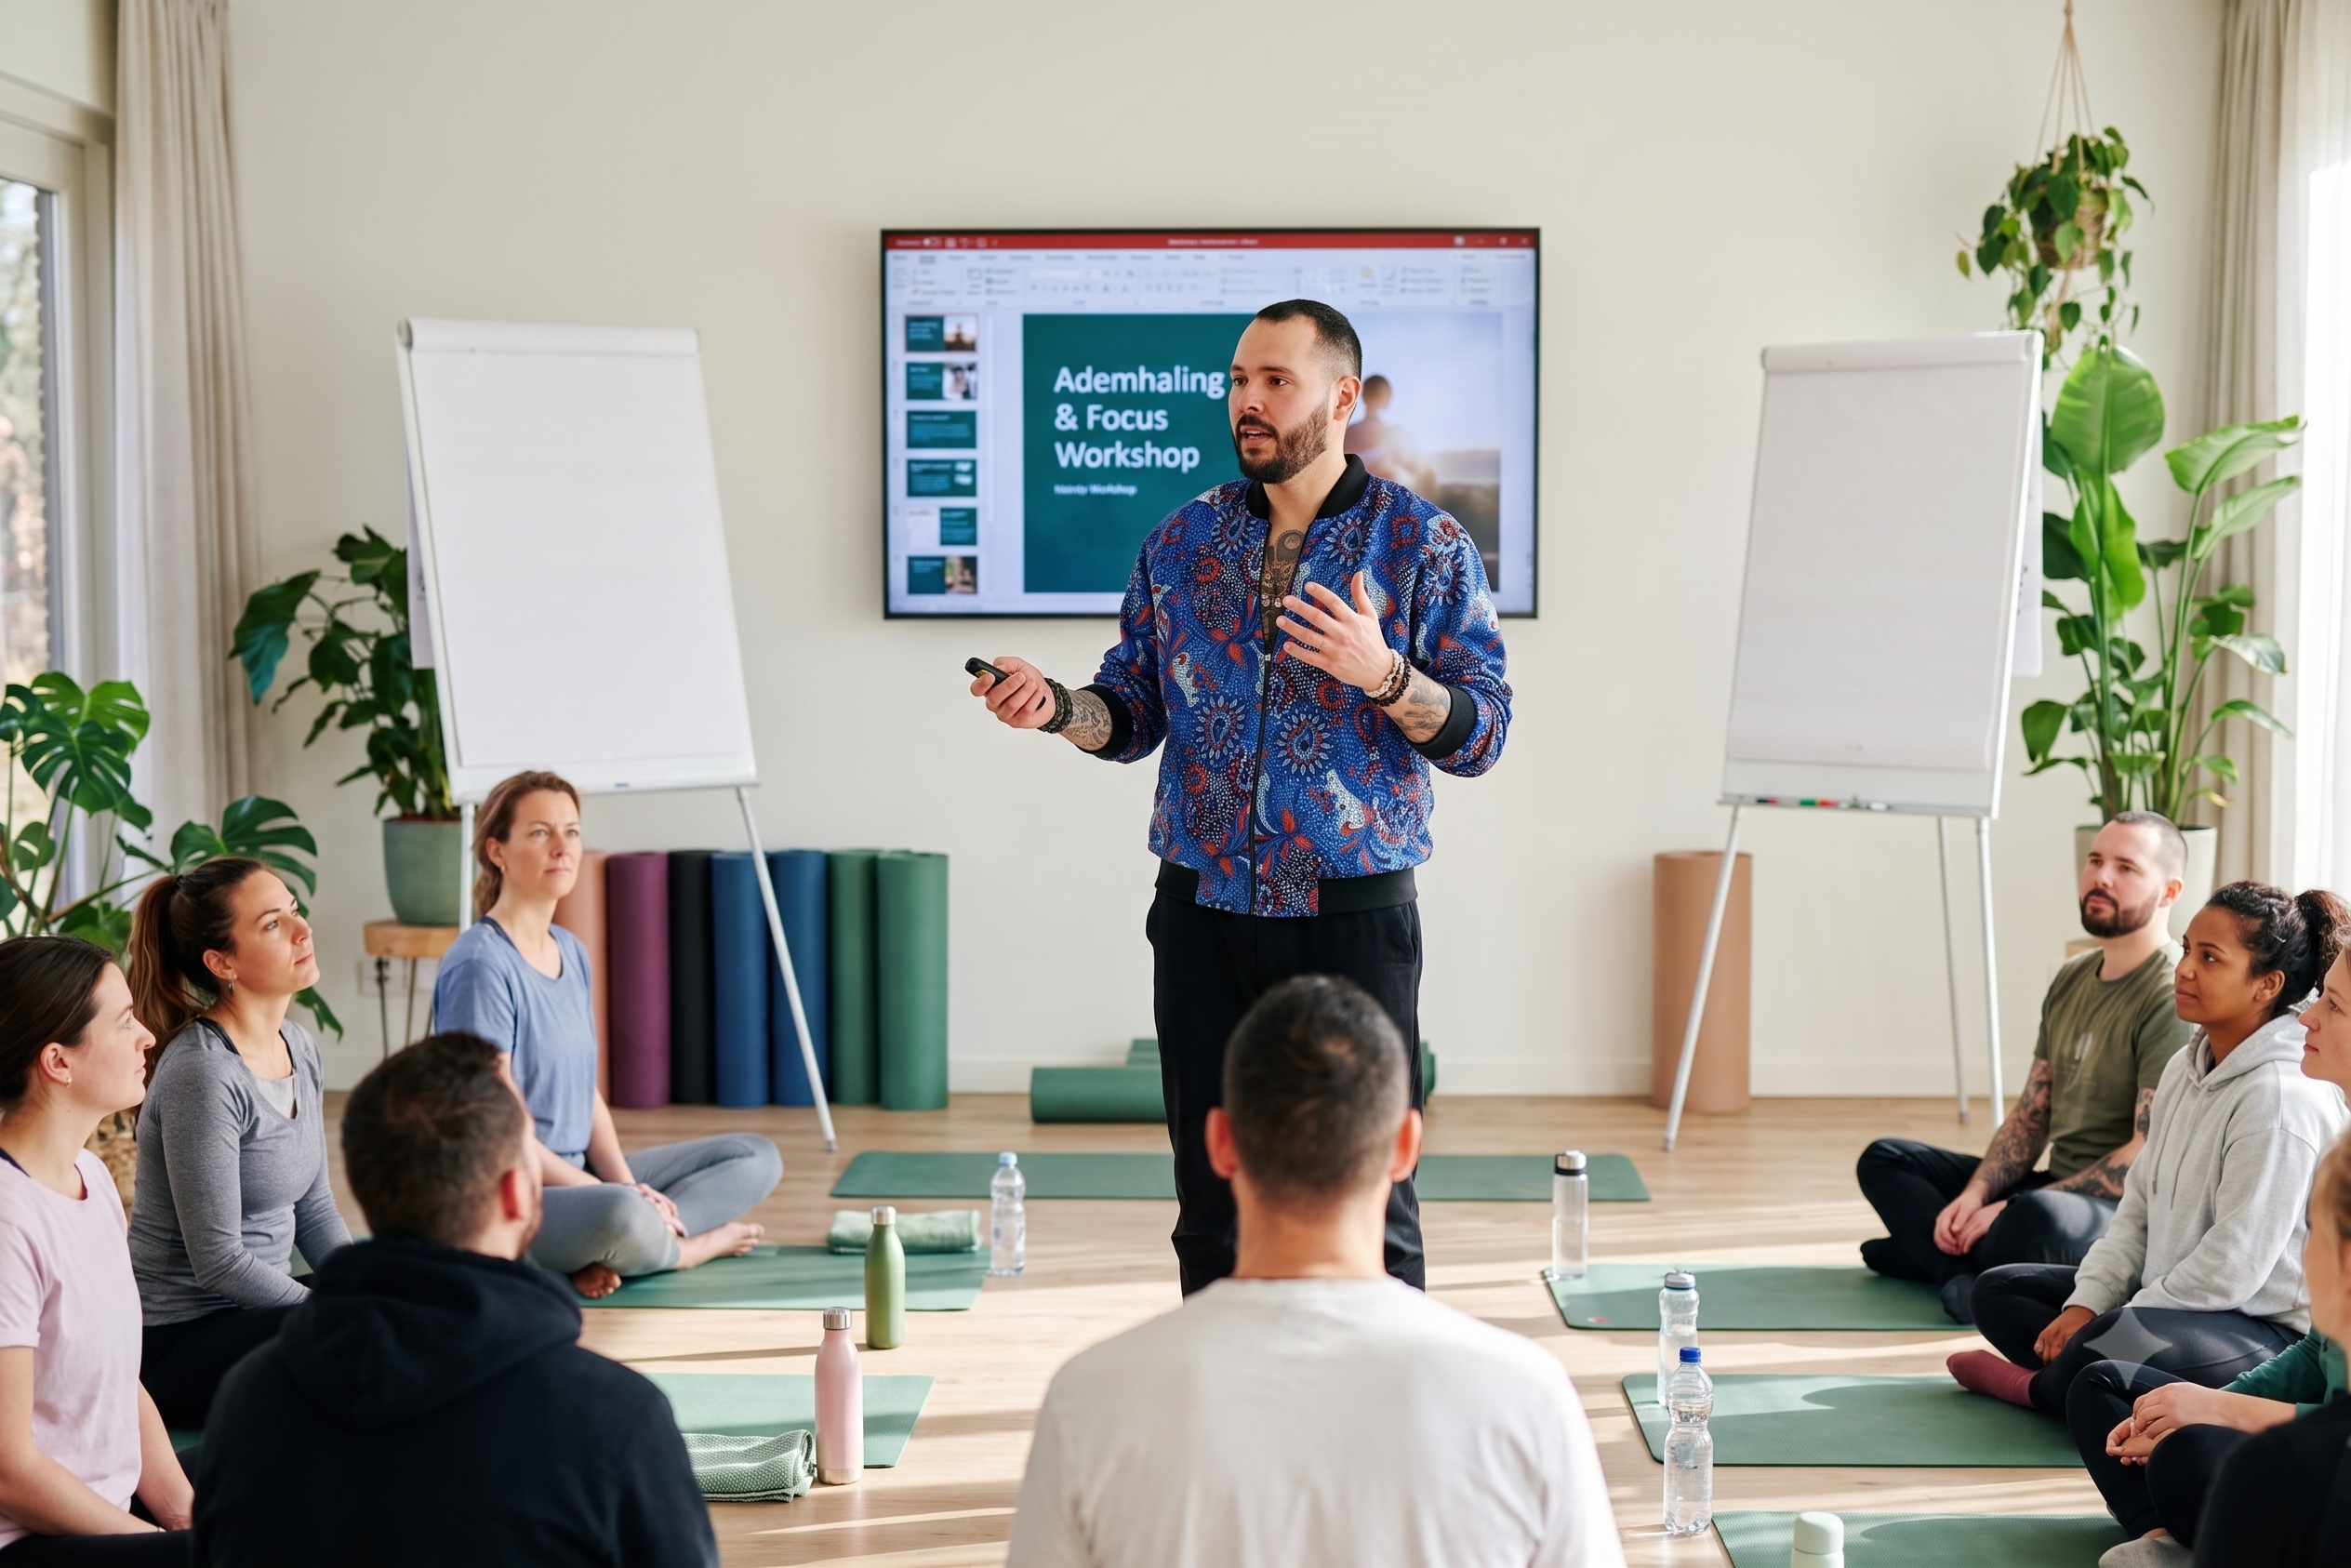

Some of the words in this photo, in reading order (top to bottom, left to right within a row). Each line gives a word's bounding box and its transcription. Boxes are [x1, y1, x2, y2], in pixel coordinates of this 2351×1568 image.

[1054, 365, 1226, 400] Ademhaling
[1054, 403, 1079, 431] &
[1086, 404, 1169, 431] Focus
[1054, 440, 1201, 474] Workshop
